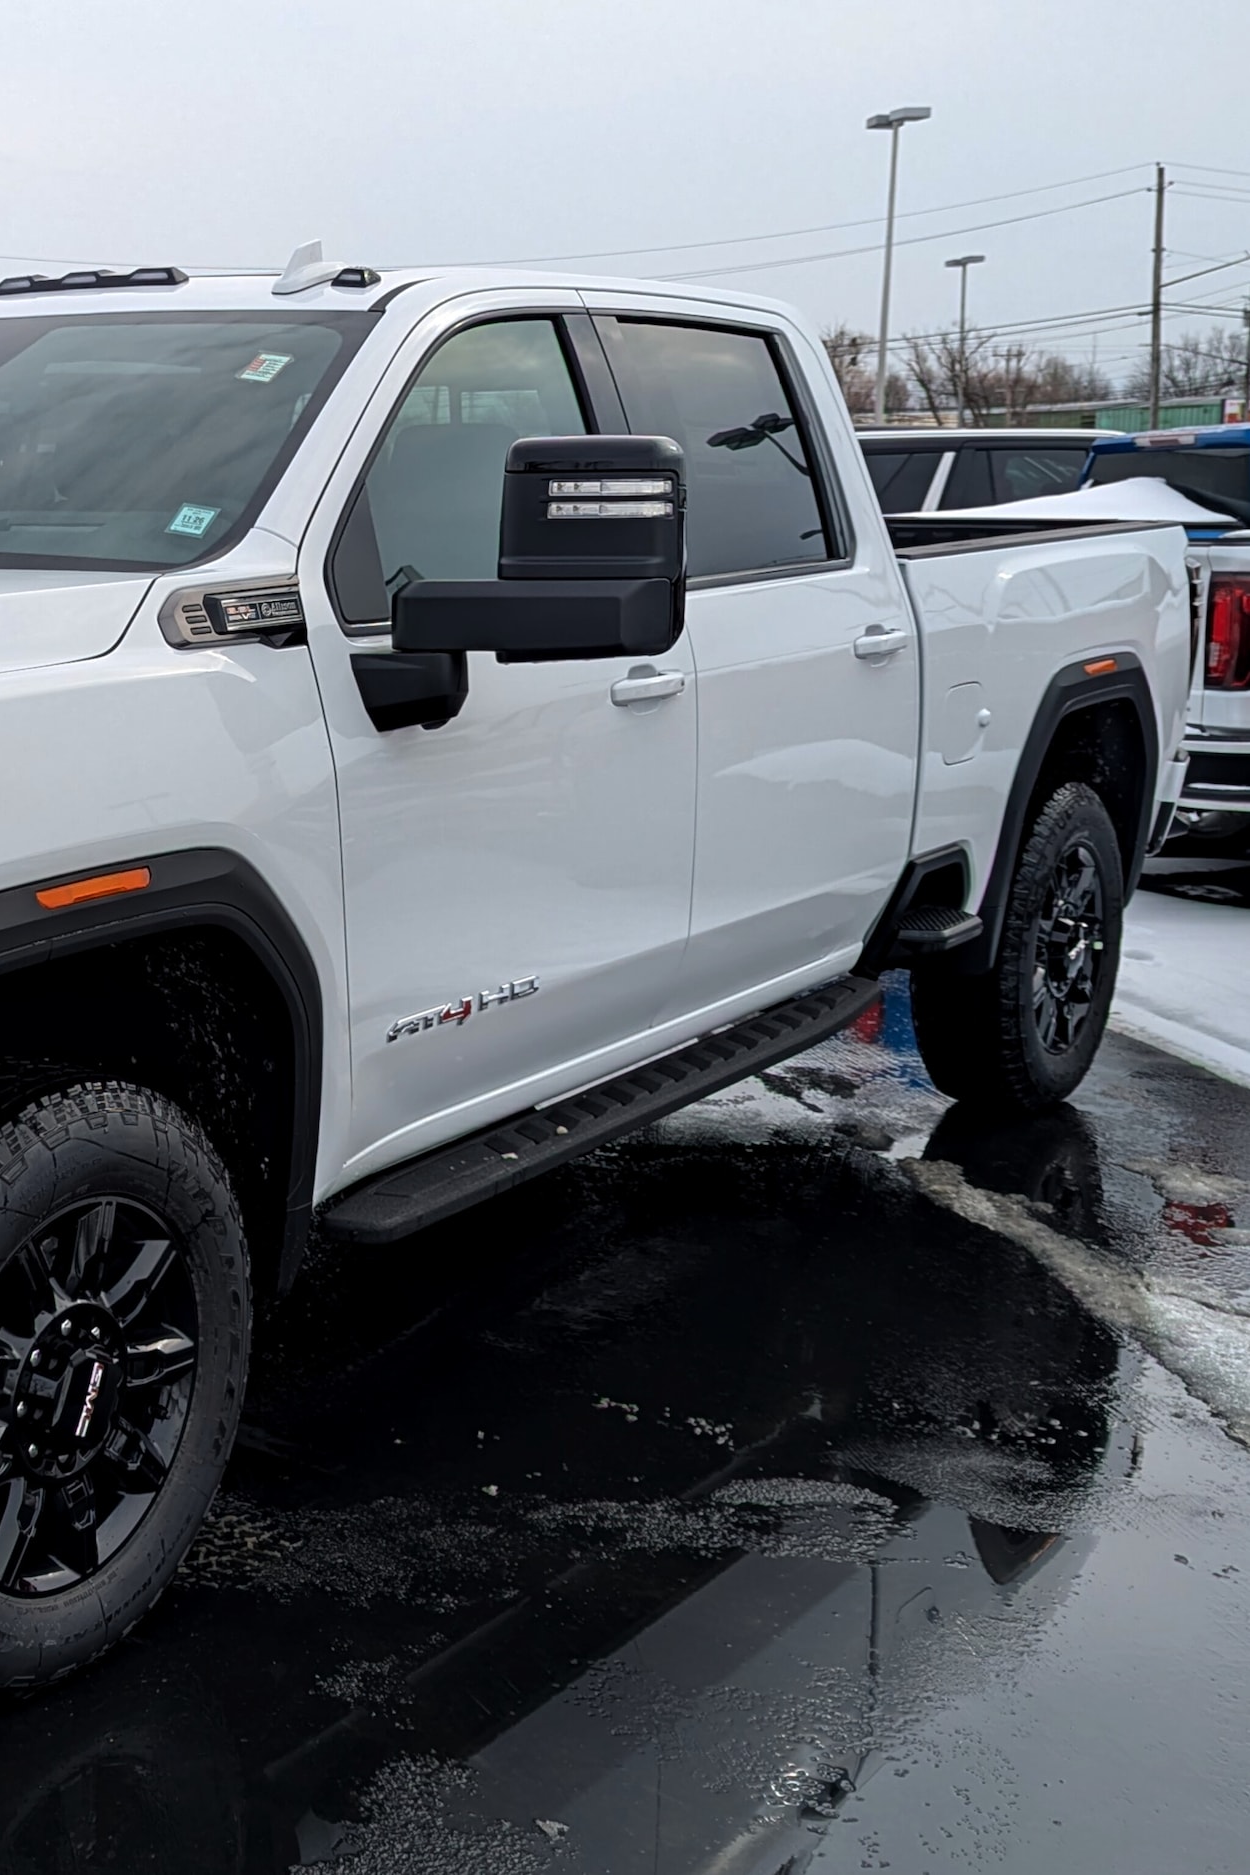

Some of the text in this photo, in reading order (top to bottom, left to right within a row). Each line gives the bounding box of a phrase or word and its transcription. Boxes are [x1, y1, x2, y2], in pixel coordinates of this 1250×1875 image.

[386, 974, 540, 1044] AT4 HD
[75, 1361, 105, 1438] GMC
